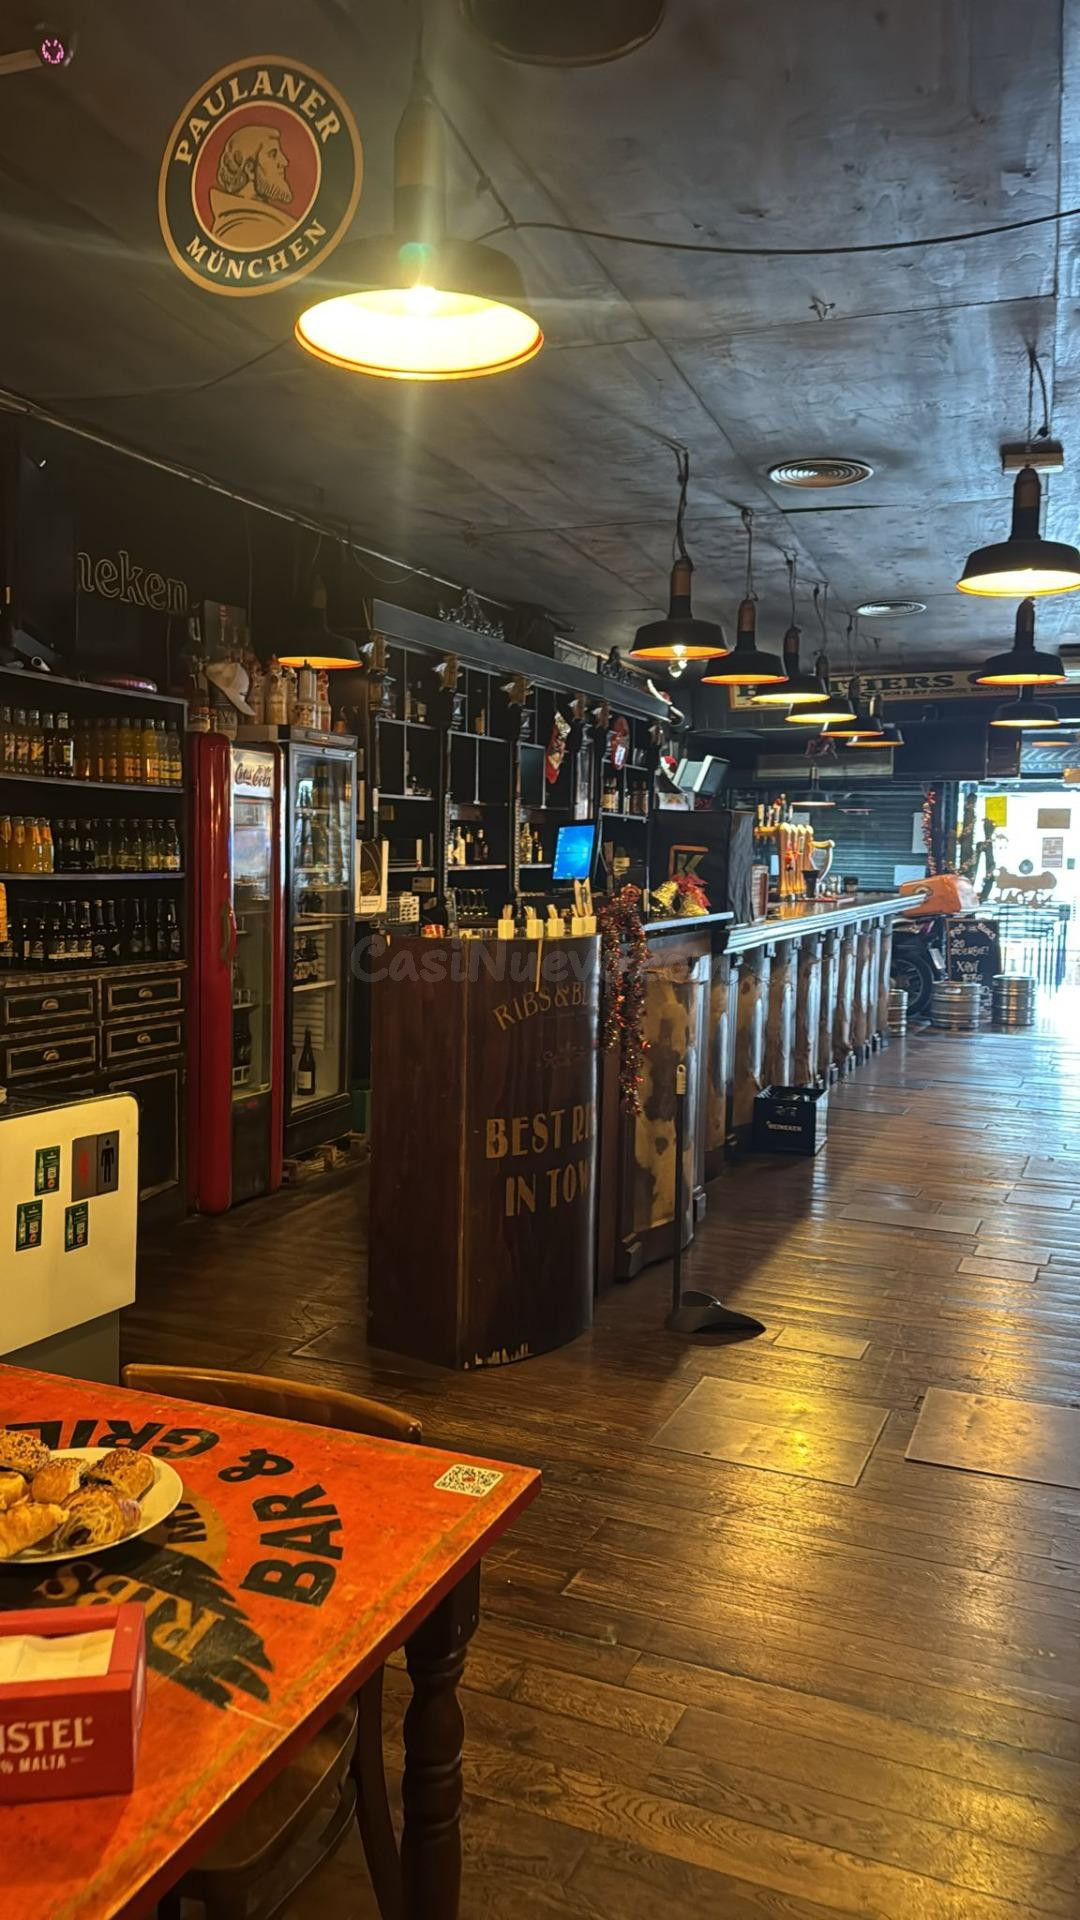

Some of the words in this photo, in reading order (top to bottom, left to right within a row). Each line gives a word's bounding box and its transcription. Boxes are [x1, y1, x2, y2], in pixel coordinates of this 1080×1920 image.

[174, 70, 342, 165] PAULANER
[185, 218, 327, 279] MÜNCHEN
[486, 1109, 566, 1159] BEST
[505, 1174, 537, 1217] IN
[217, 1448, 294, 1483] &
[239, 1483, 344, 1607] BAR
[19, 1753, 67, 1774] MALTA
